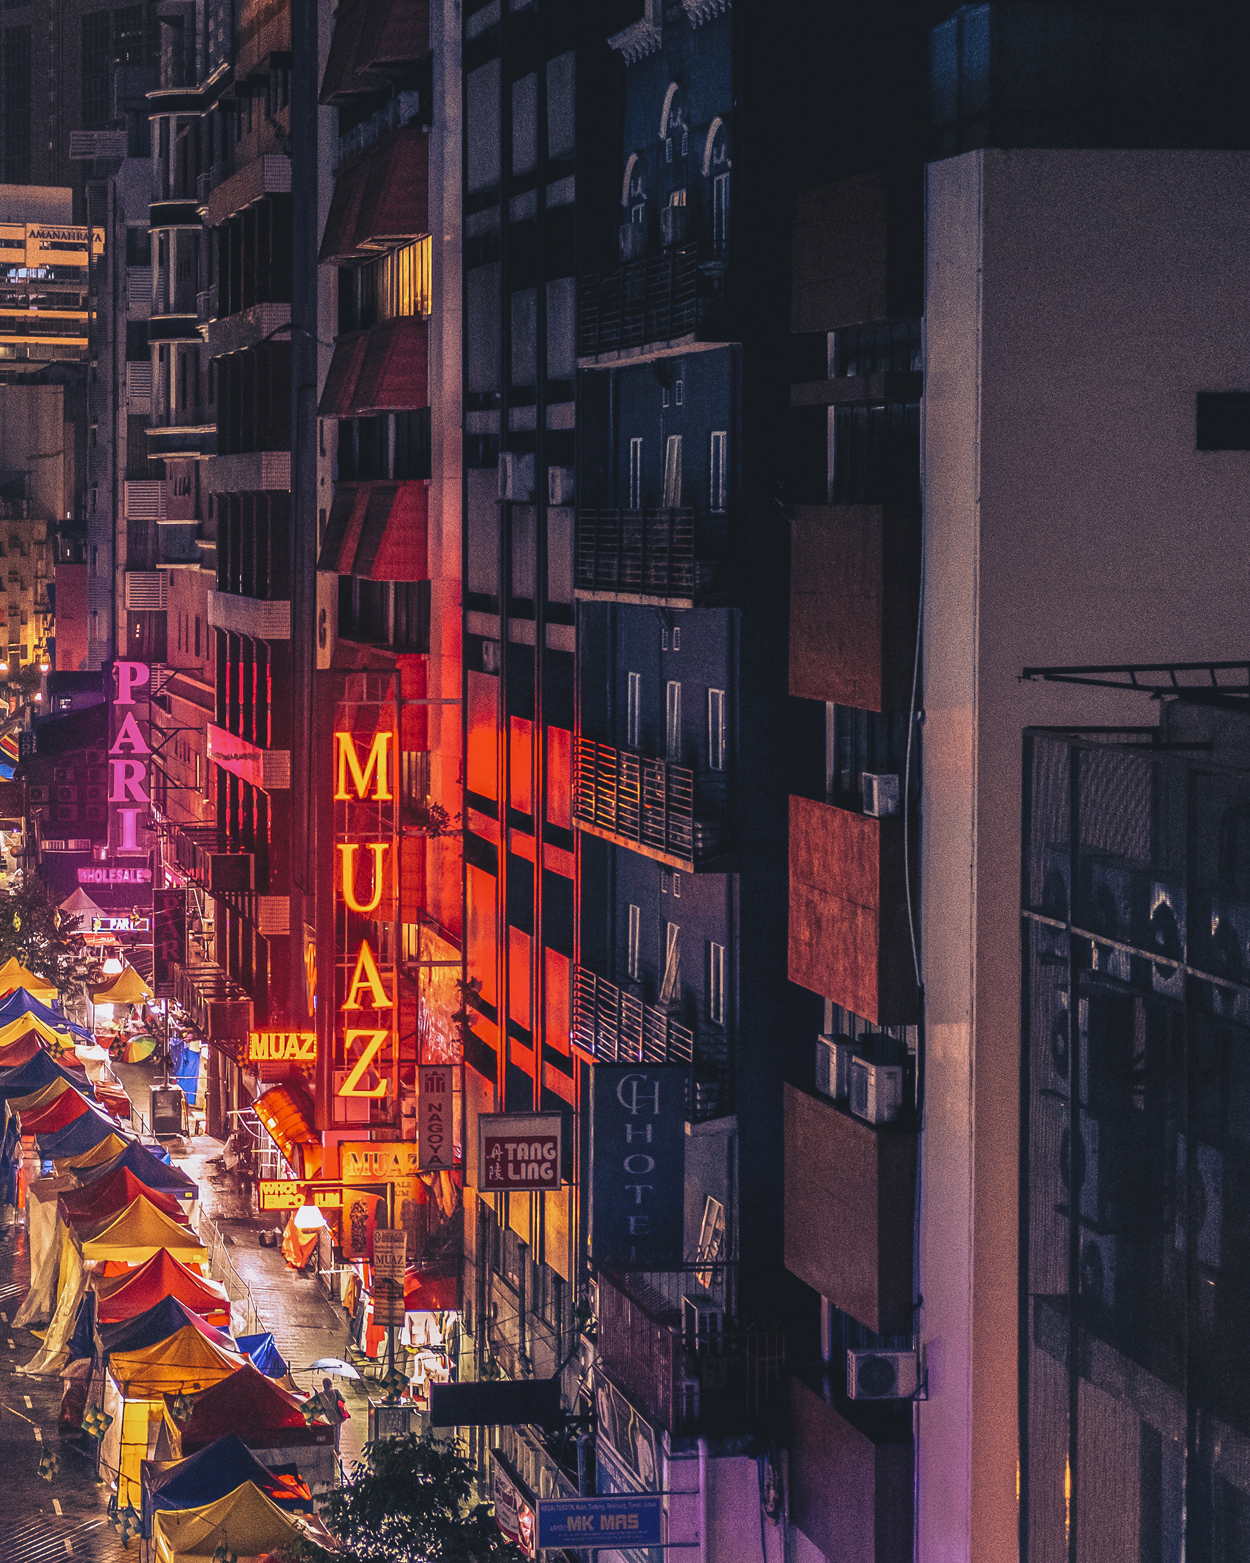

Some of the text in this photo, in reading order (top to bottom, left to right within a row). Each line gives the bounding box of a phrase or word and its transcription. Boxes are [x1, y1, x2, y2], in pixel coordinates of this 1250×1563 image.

[29, 229, 102, 242] AMANAHRAA
[108, 661, 150, 852] PARI
[334, 731, 394, 1098] MUAZ
[251, 1034, 315, 1059] MUAZ
[427, 1103, 444, 1164] NAGOYA
[505, 1142, 557, 1160] TANG
[348, 1152, 418, 1177] MUAZ
[507, 1162, 554, 1180] LING
[375, 1255, 403, 1265] MUAZ
[567, 1515, 594, 1531] MK
[600, 1514, 640, 1530] MAS
